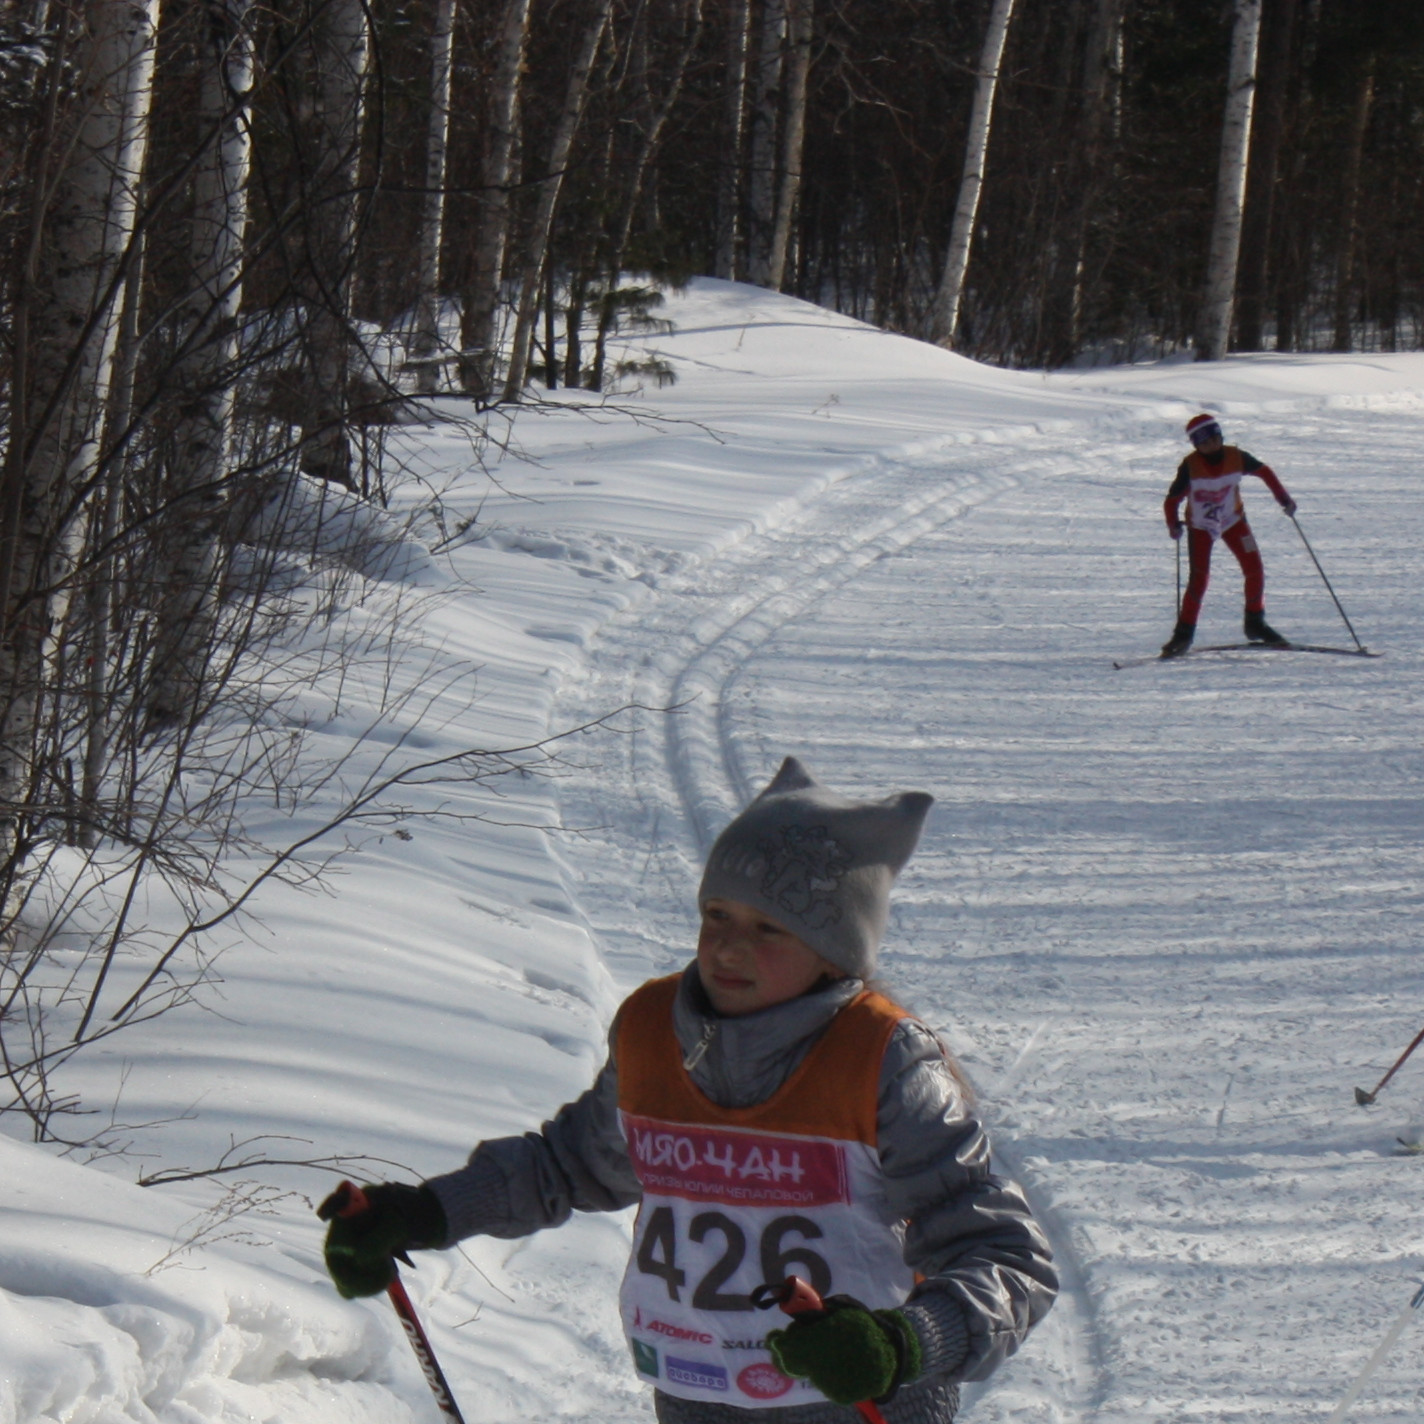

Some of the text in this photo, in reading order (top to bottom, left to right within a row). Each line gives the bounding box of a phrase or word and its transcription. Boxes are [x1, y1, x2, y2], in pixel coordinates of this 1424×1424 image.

[635, 1129, 805, 1182] МЯО-ЧАН
[683, 1180, 725, 1194] ЮЛИИ
[726, 1185, 814, 1202] ЧЕПАЛОВОЙ
[637, 1206, 832, 1312] 426
[647, 1320, 714, 1345] ATOMIC
